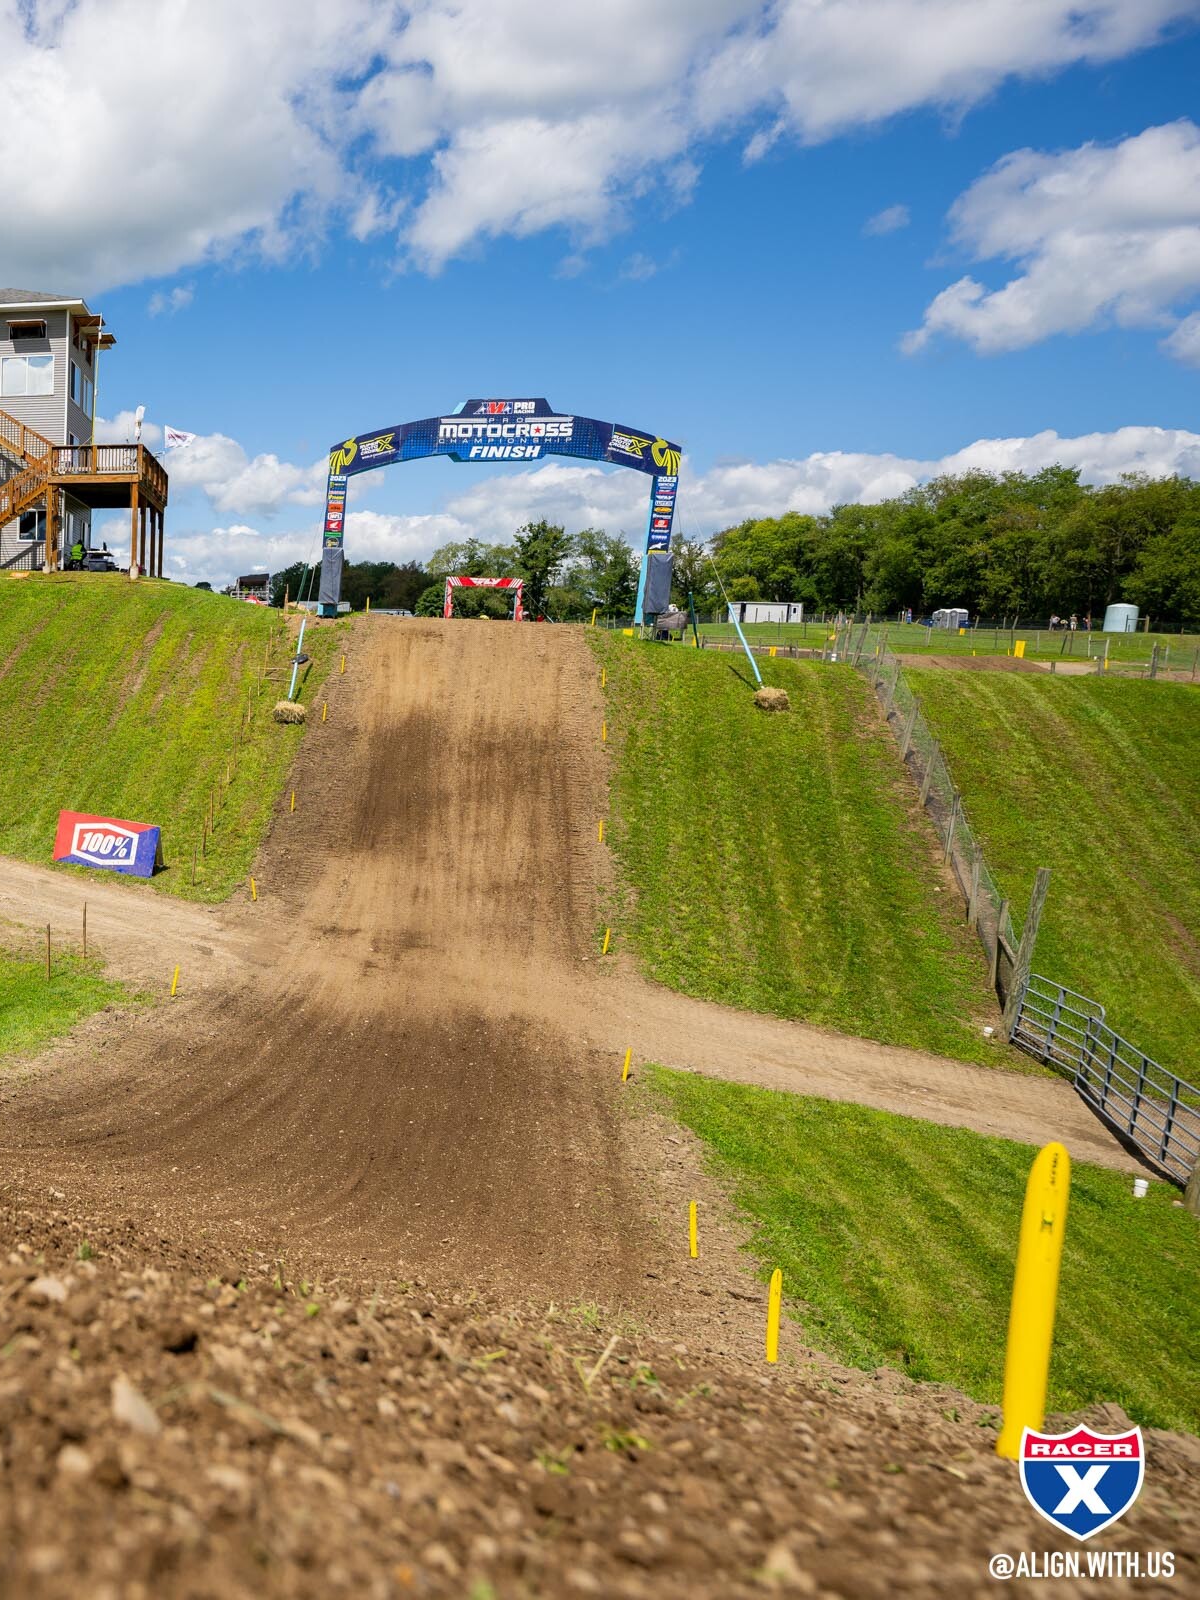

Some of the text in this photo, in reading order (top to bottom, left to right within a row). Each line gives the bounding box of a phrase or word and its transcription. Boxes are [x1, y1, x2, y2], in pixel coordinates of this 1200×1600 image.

[473, 402, 513, 414] AMA
[514, 402, 535, 410] PRO
[439, 423, 573, 438] MOTOCROSS
[469, 445, 542, 458] FINISH
[81, 832, 130, 858] 100%
